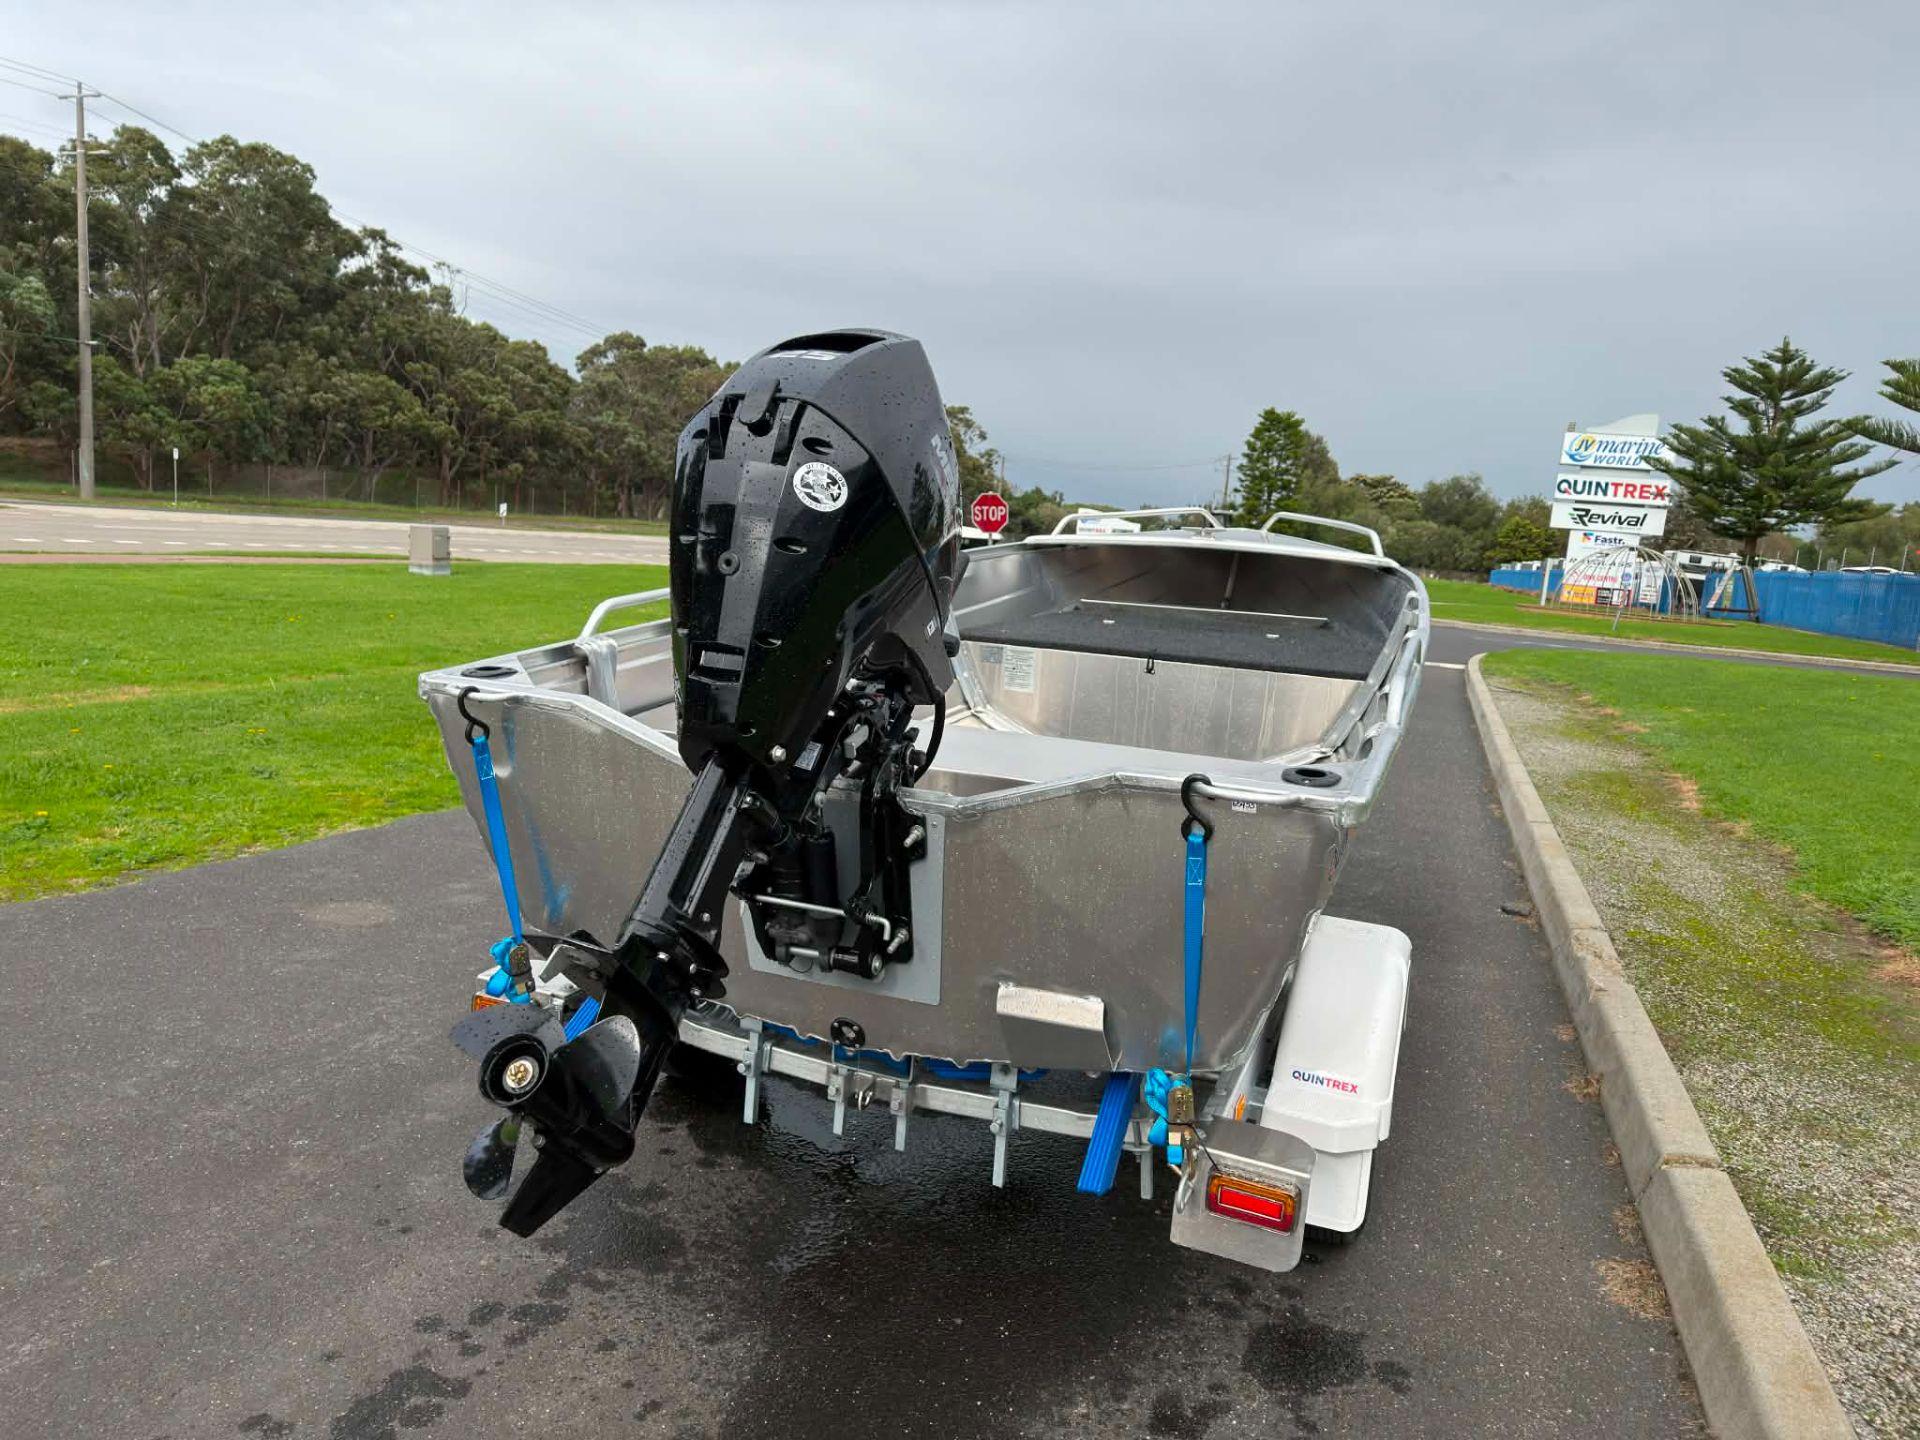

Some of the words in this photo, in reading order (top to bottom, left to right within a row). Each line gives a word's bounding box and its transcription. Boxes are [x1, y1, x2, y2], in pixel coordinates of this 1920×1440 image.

[1575, 438, 1596, 452] JV
[1595, 437, 1665, 455] marine
[1593, 454, 1643, 466] WORLD
[1557, 479, 1669, 501] QUINTREX
[974, 505, 1006, 522] STOP
[1570, 507, 1648, 527] Revival
[1292, 1070, 1359, 1094] QUINTREX
